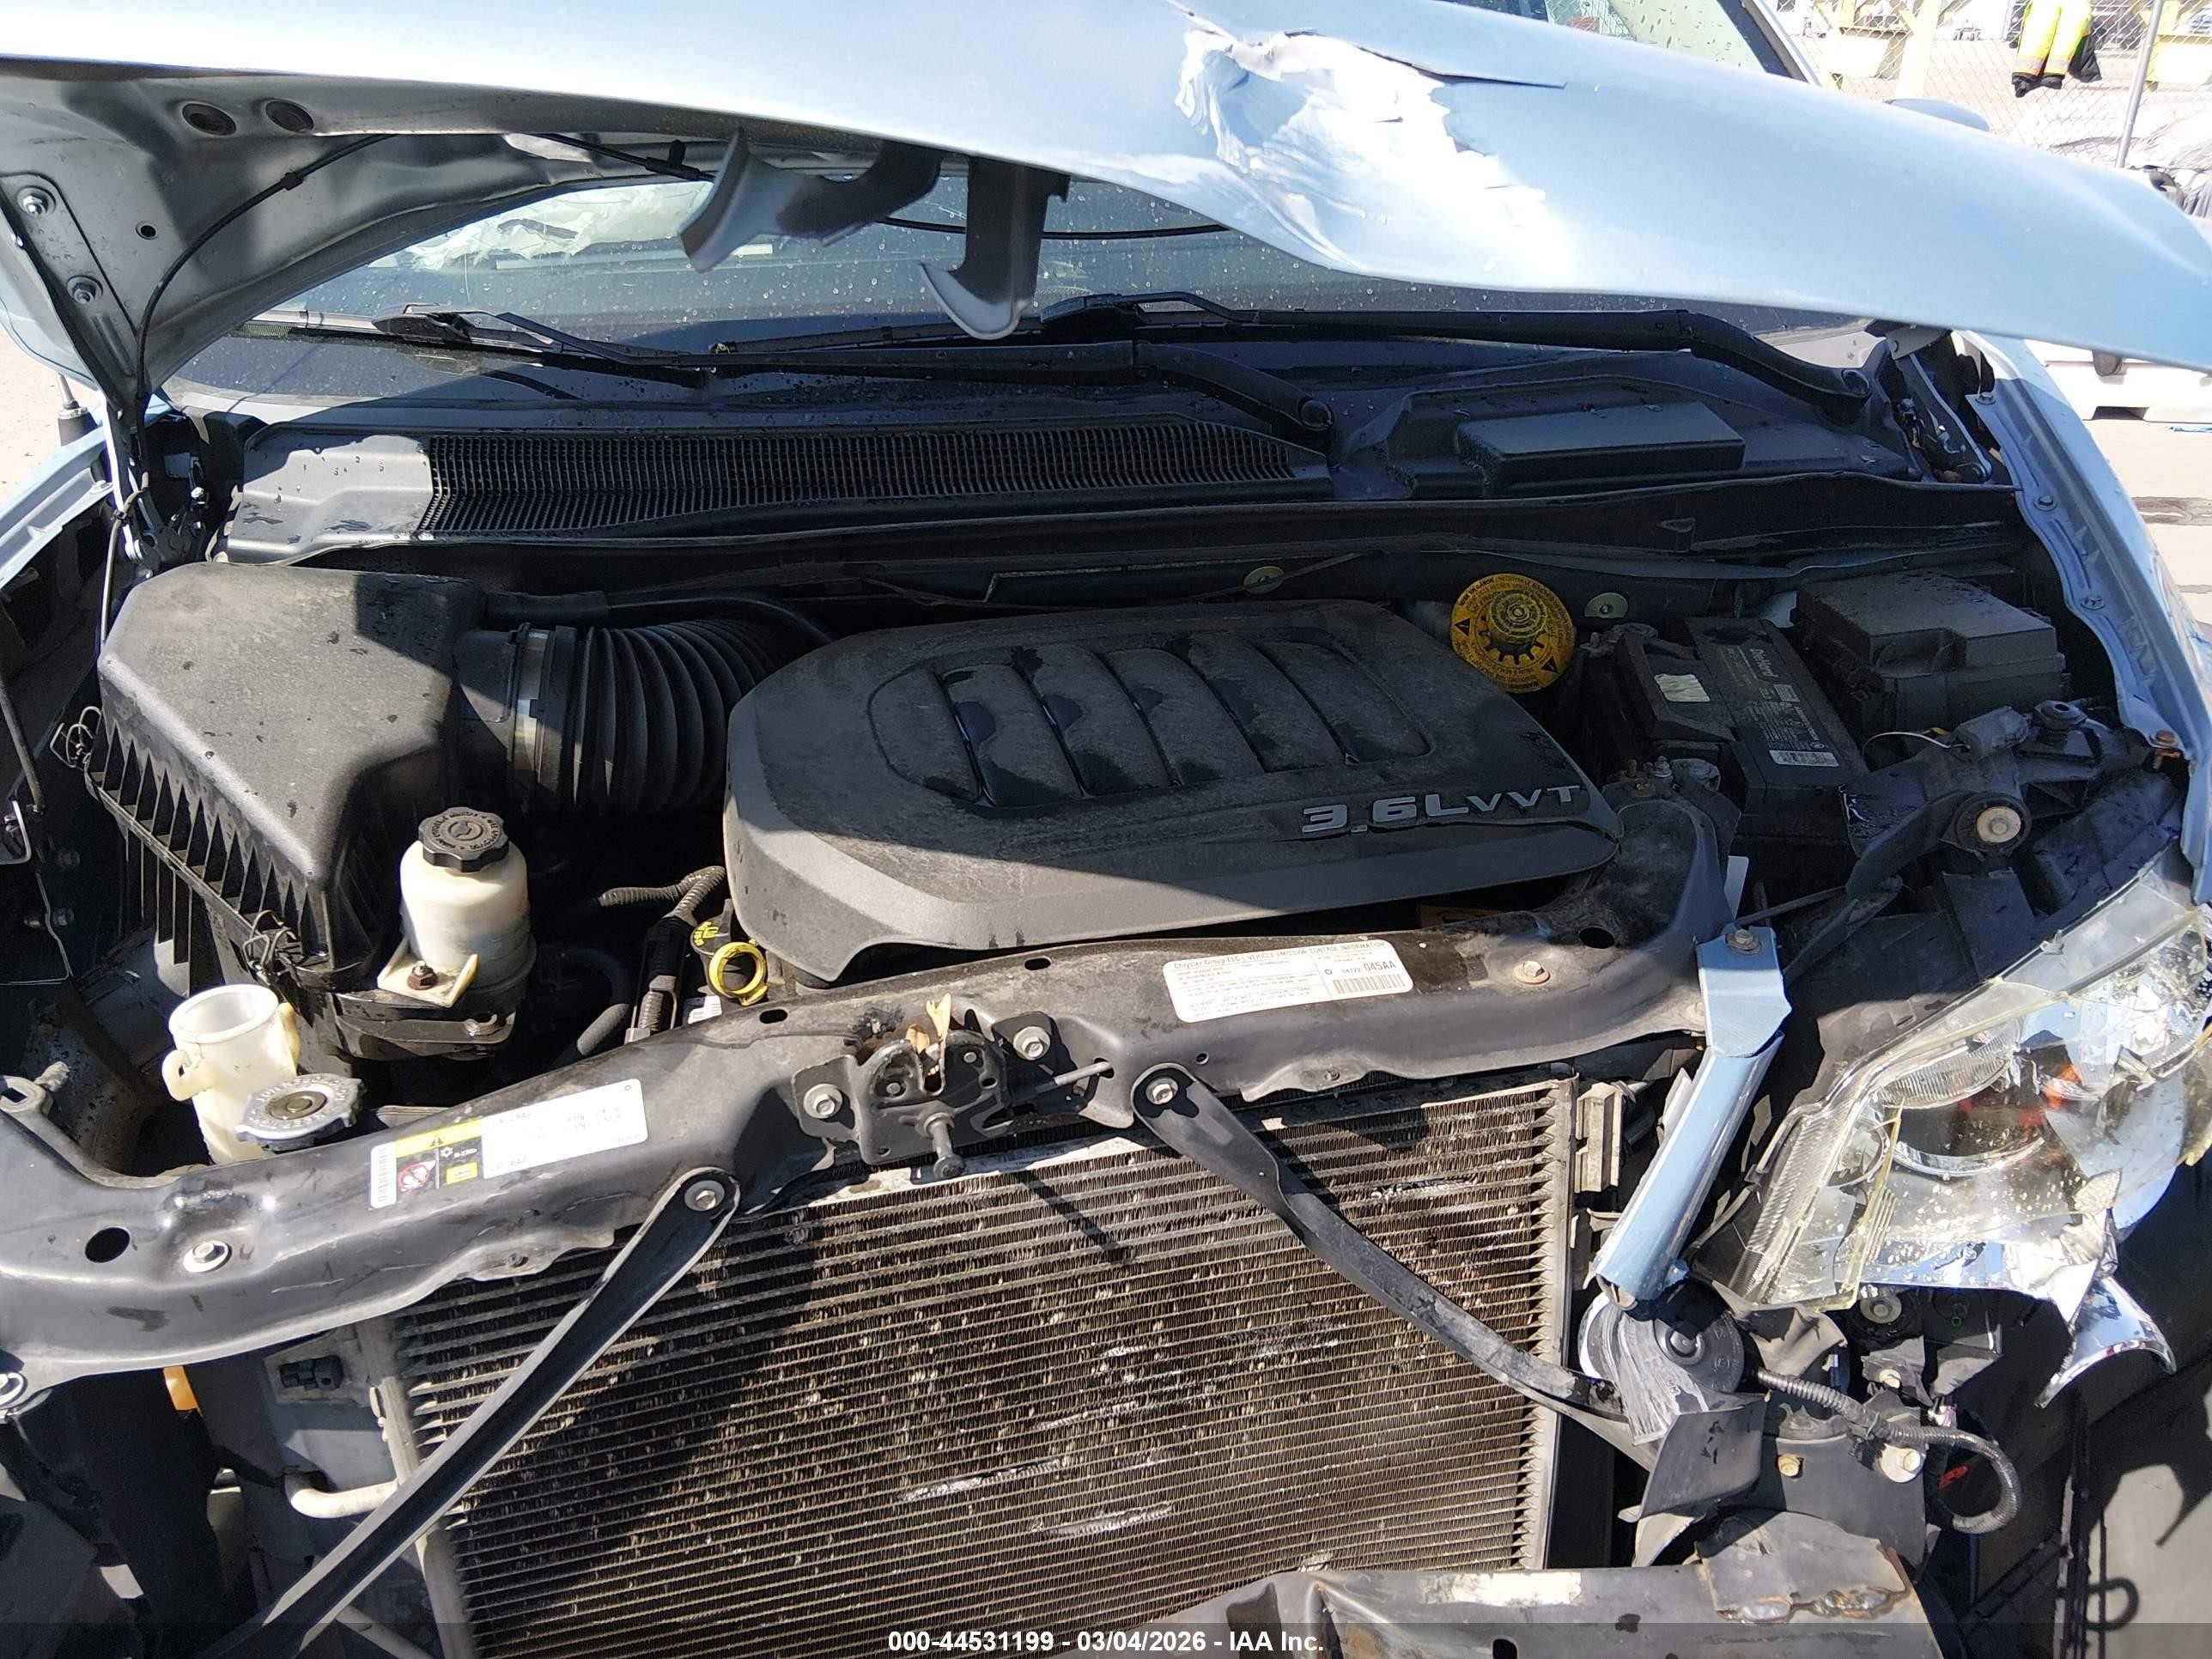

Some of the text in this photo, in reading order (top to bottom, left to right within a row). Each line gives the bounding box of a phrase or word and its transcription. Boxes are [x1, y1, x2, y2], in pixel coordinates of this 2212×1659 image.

[1749, 647, 1779, 678] DieHard
[1302, 785, 1581, 833] 3.6L VVT
[1174, 960, 1203, 969] Chrysler
[1204, 957, 1226, 966] Group
[1248, 951, 1274, 961] VEHICLE
[1277, 948, 1309, 957] EMISSION
[1310, 945, 1340, 955] CONTROL
[1340, 941, 1385, 951] INFORMATION
[1364, 960, 1397, 971] 045AA
